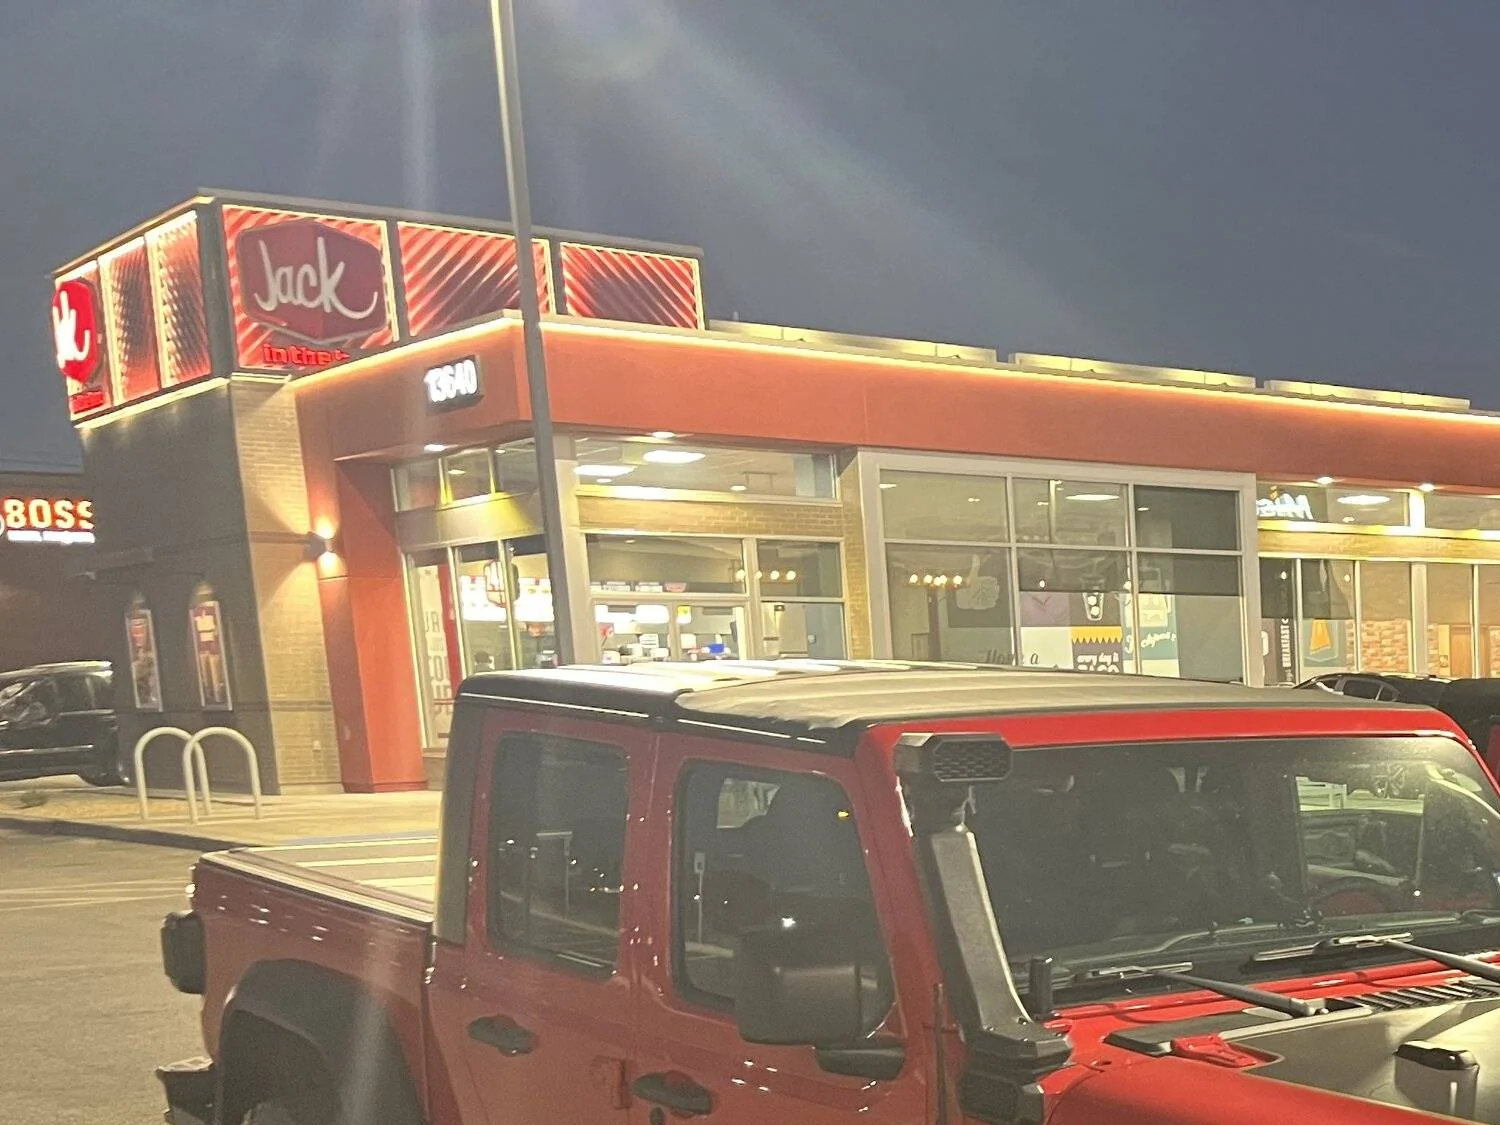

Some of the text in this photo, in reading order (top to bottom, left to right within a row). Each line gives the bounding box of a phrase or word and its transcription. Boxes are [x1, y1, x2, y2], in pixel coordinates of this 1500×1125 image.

[253, 236, 379, 320] Jack
[263, 343, 287, 363] in
[288, 345, 334, 366] the
